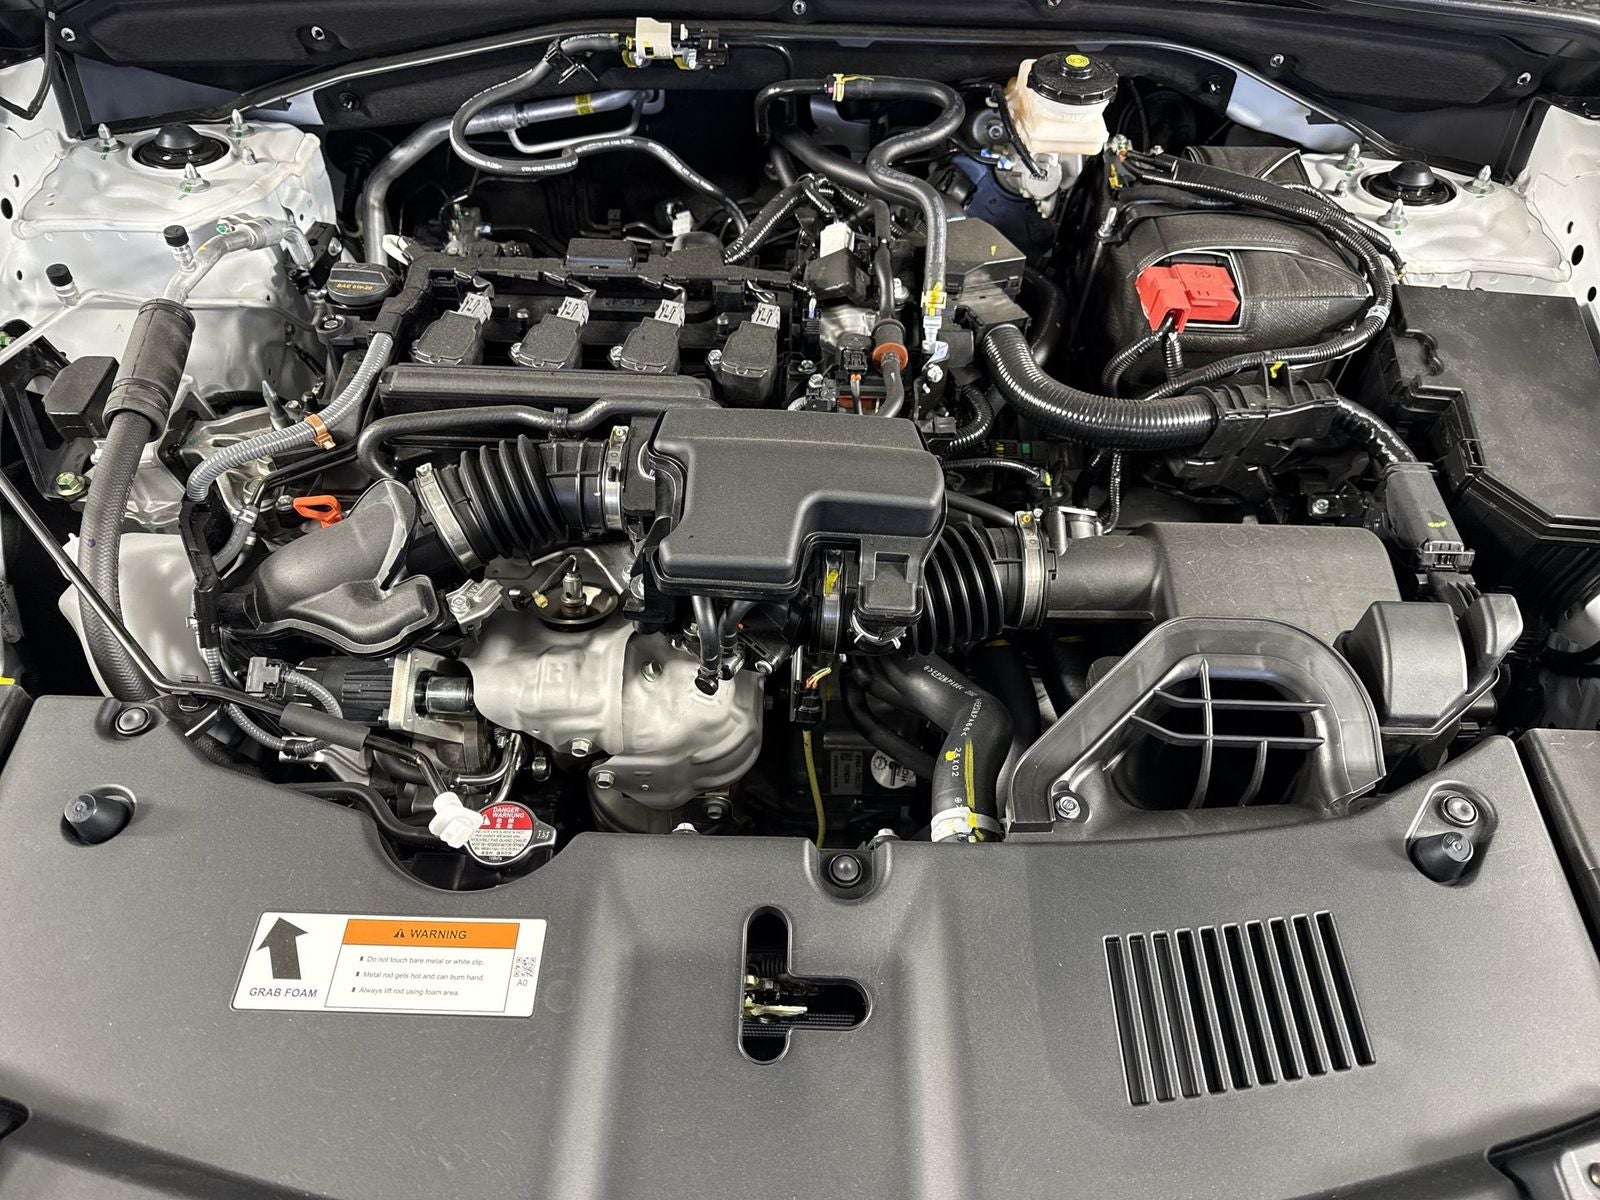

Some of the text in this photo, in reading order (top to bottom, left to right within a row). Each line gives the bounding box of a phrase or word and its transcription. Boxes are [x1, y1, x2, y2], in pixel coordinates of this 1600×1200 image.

[410, 929, 467, 940] WARNING
[377, 956, 389, 964] not
[390, 956, 408, 964] touch
[425, 957, 444, 965] metal
[453, 958, 471, 966] white
[472, 958, 485, 966] clip.
[394, 973, 409, 981] gets
[249, 987, 318, 998] GRAB FOAM
[359, 987, 382, 996] Always
[405, 988, 423, 997] using
